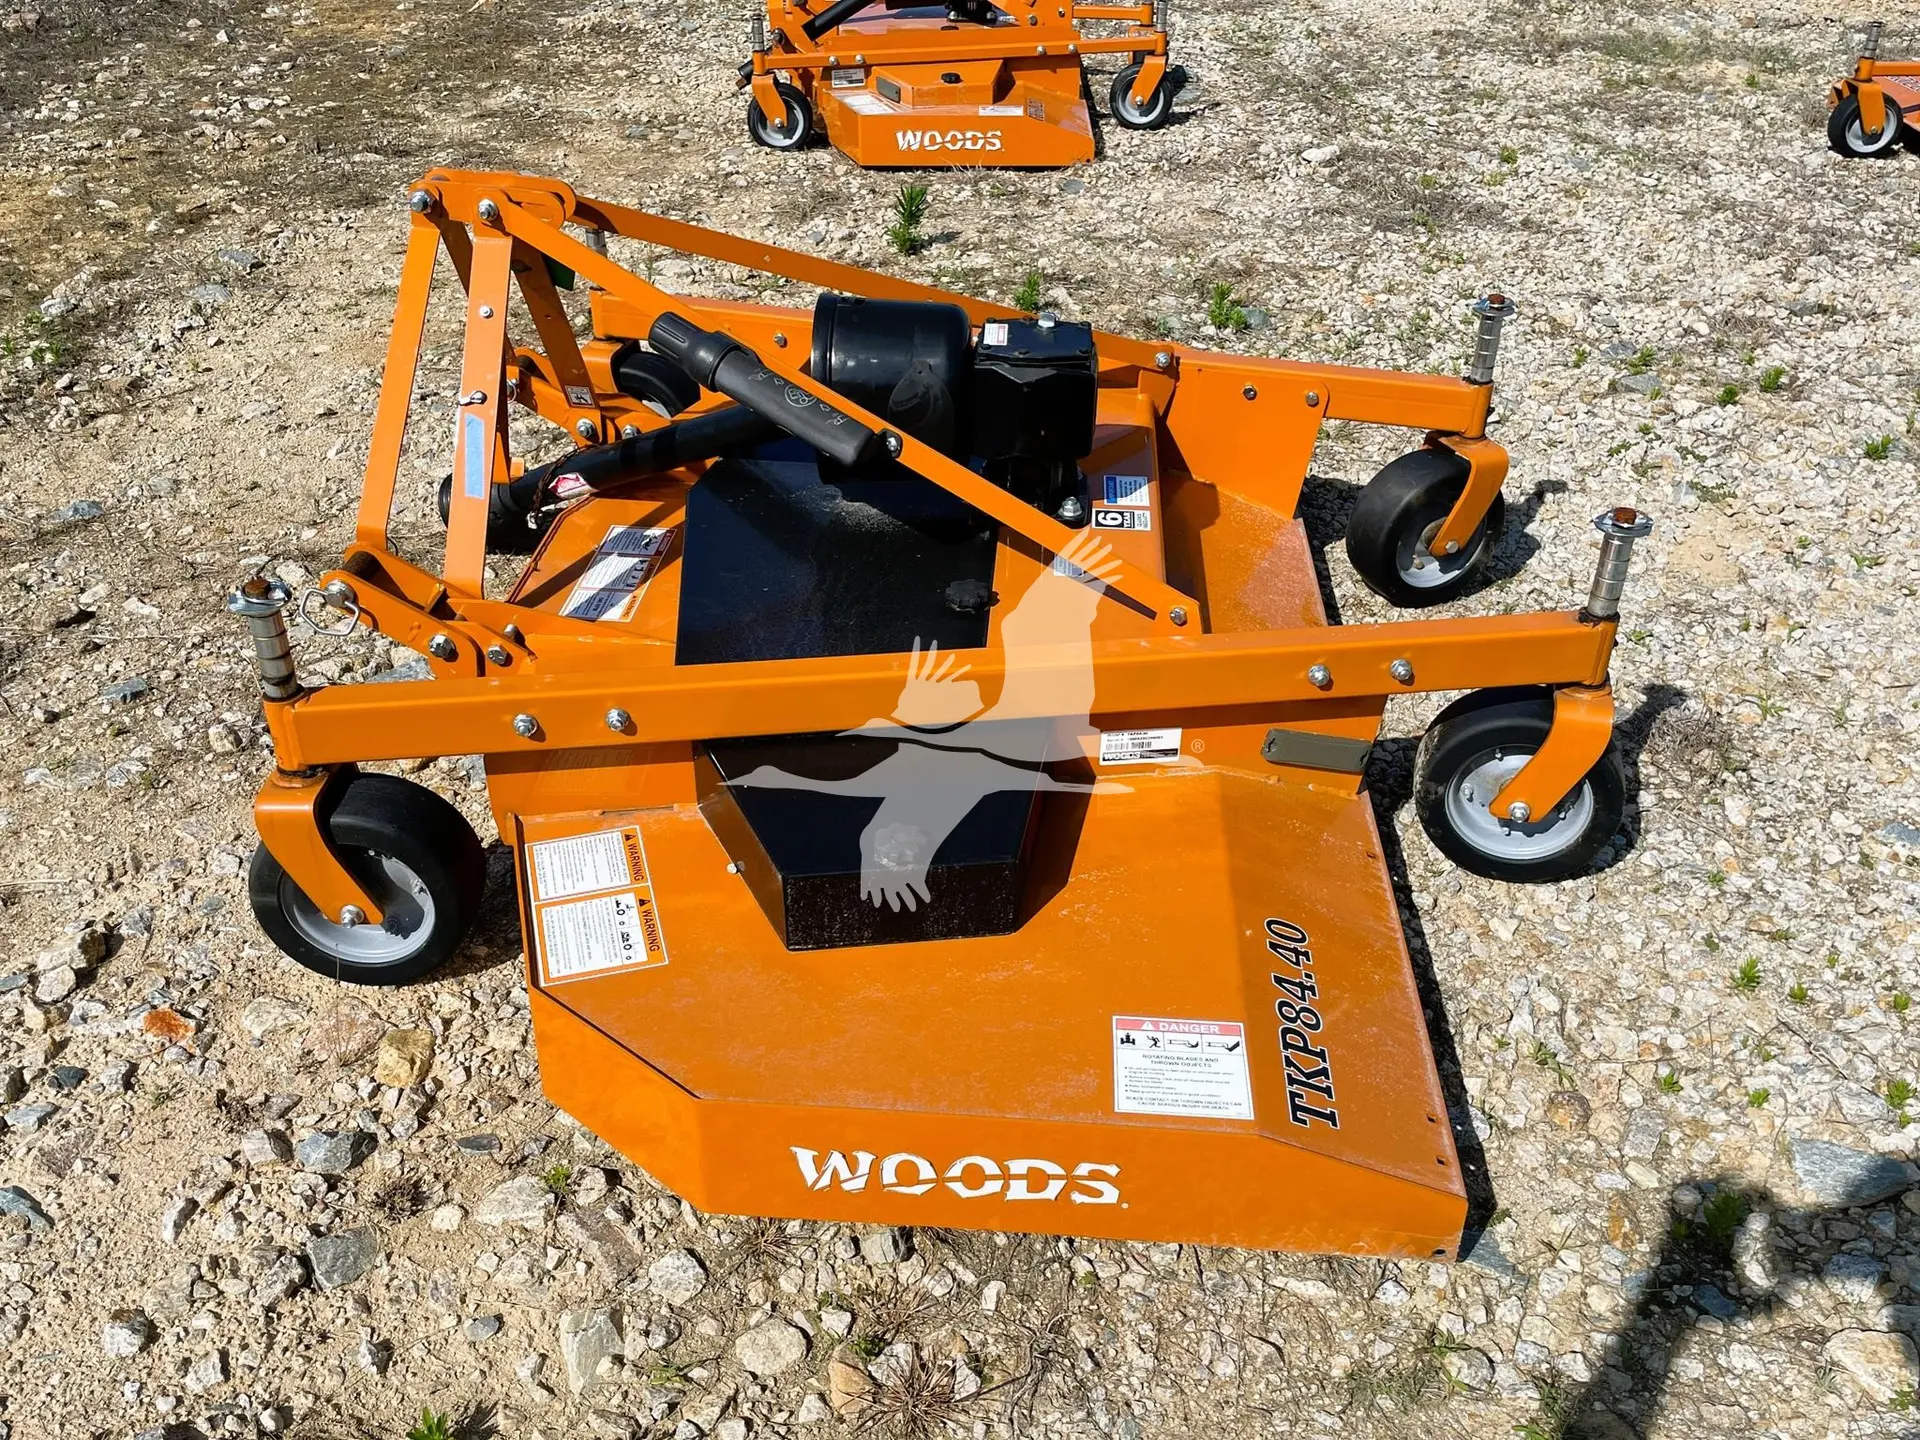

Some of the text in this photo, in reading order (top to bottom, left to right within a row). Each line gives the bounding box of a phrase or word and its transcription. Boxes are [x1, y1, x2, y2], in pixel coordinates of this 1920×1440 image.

[895, 130, 1003, 151] WOODS
[1097, 511, 1123, 526] 6
[627, 842, 645, 882] WARNING
[641, 908, 661, 953] WARNING
[1159, 1023, 1220, 1034] DANGER
[1264, 917, 1340, 1130] TKP84.40
[789, 1146, 1122, 1204] WOODS
